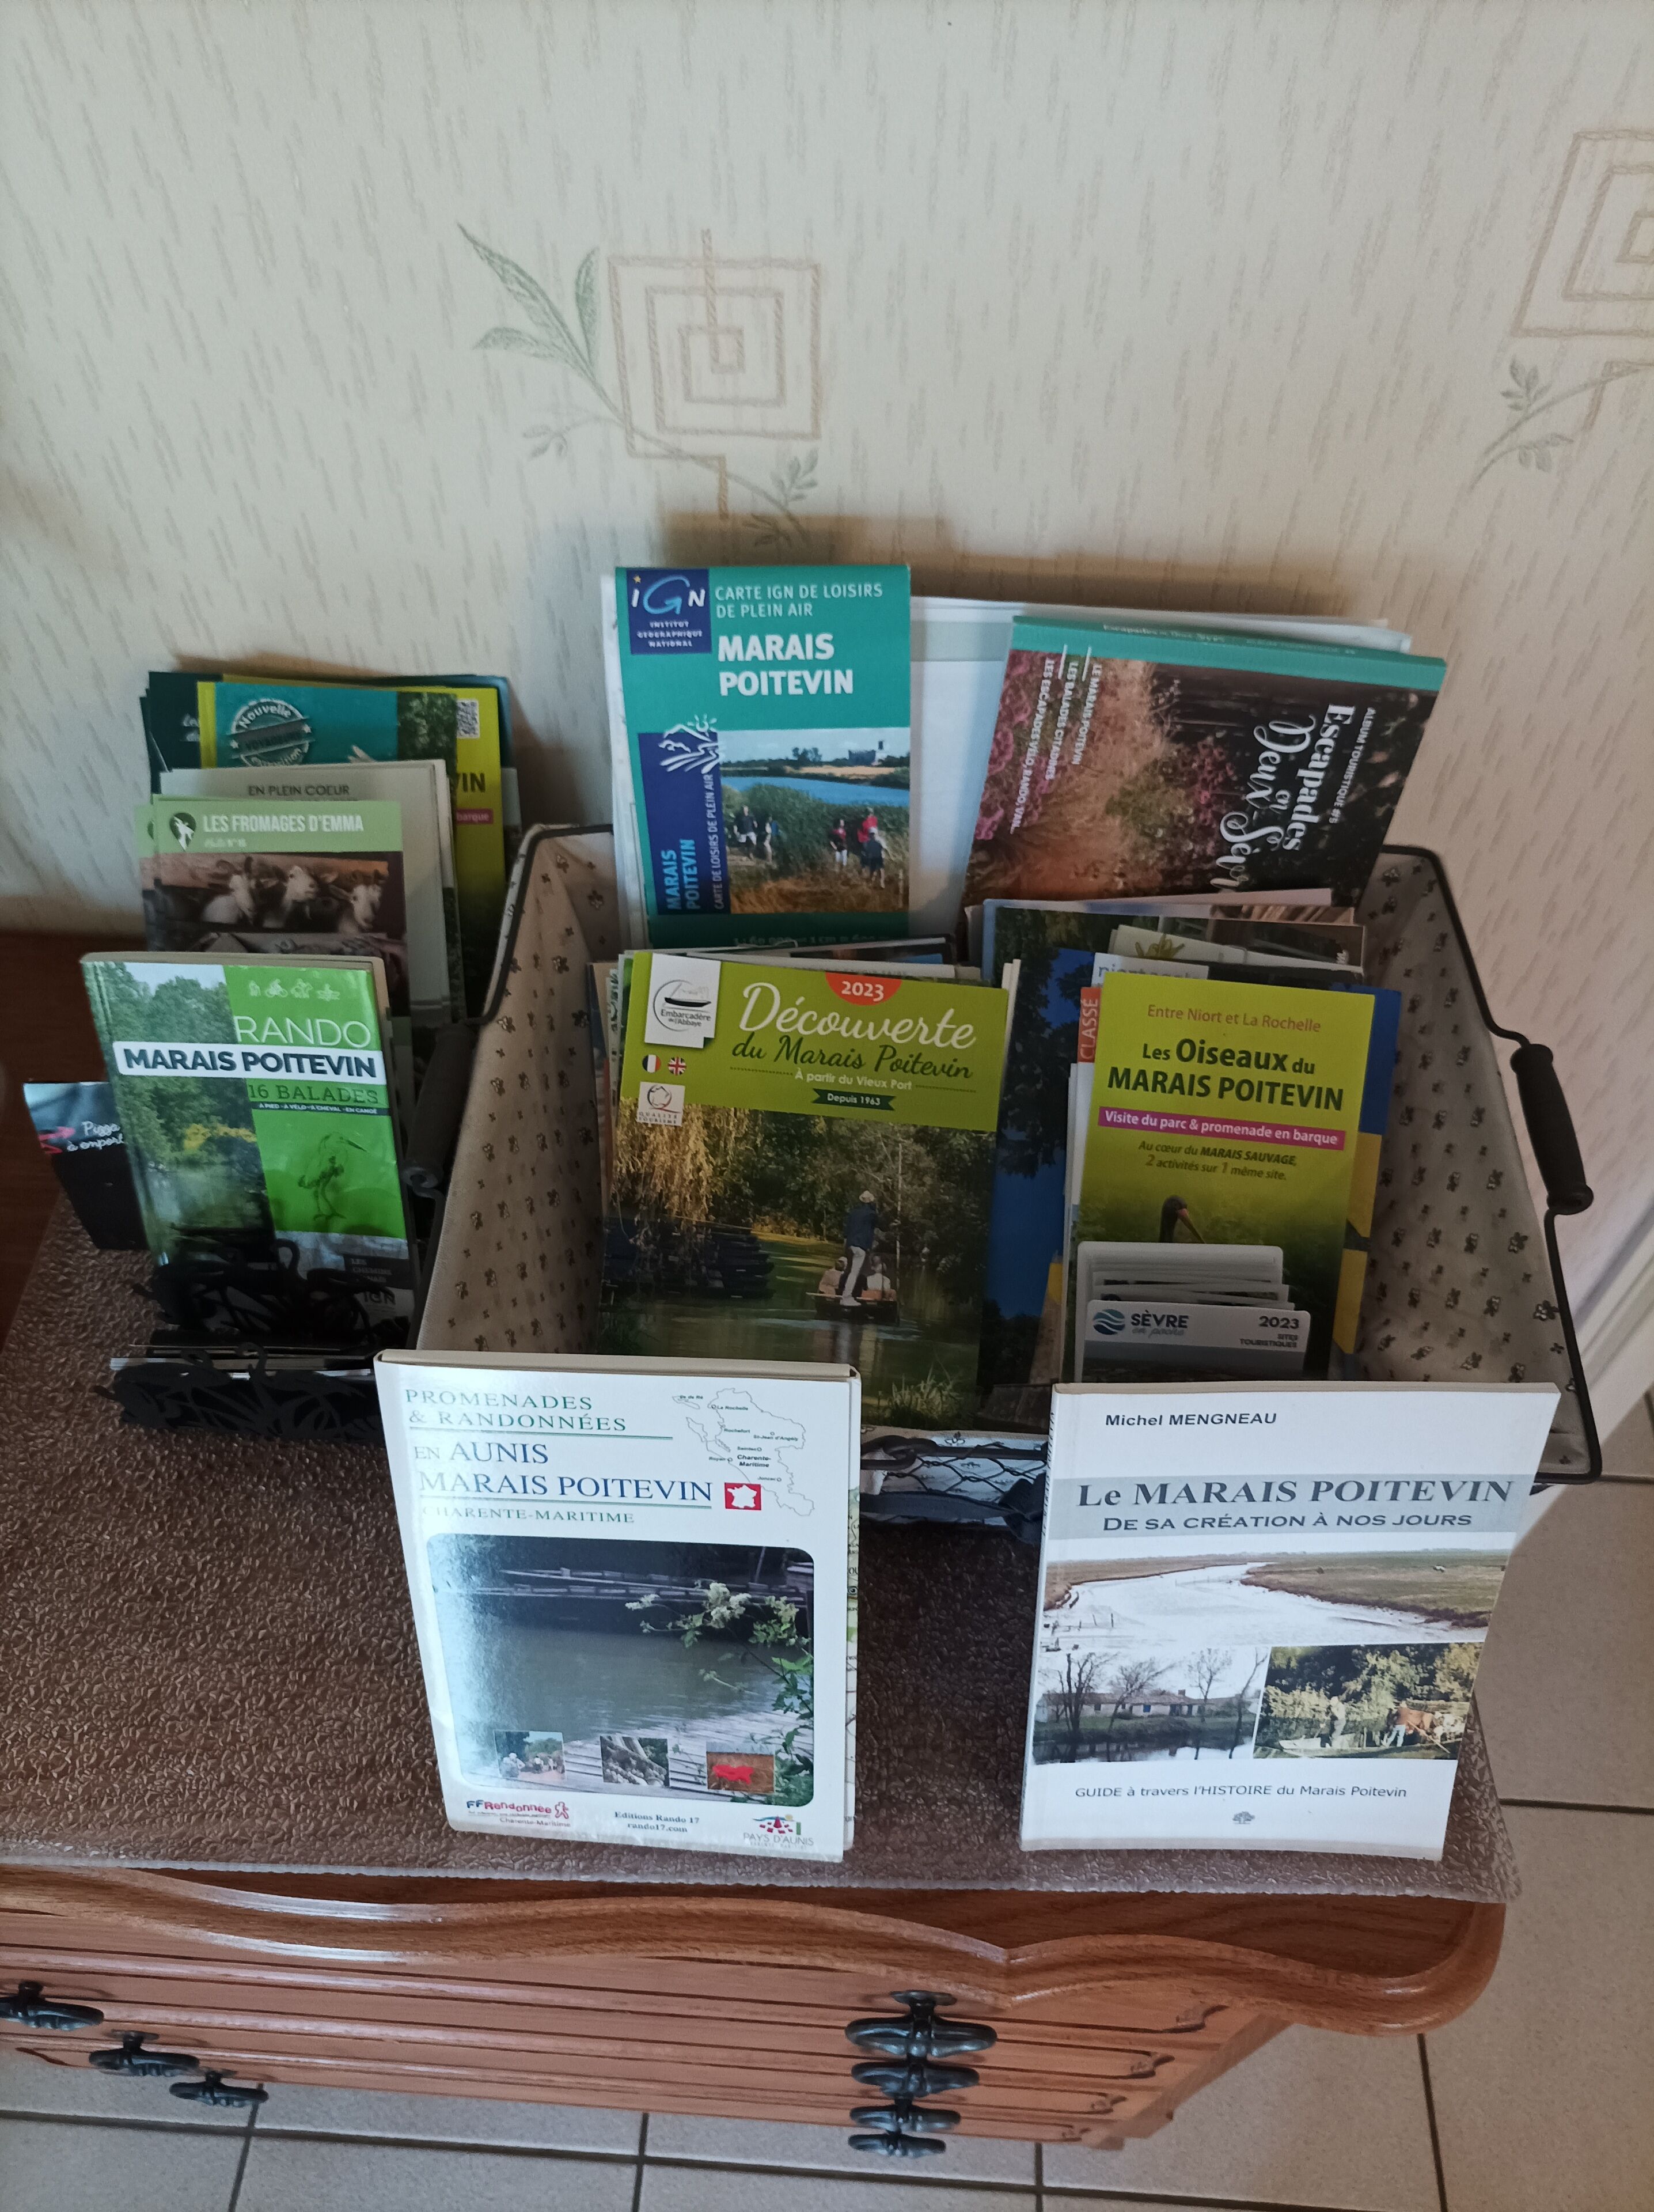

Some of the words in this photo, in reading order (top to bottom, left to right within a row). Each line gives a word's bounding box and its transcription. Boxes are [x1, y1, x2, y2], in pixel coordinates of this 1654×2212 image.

[631, 575, 705, 614] IGN
[715, 586, 761, 602] CARTE
[767, 585, 794, 600] IGN
[799, 585, 818, 599] DE
[823, 583, 883, 598] LOISIRS
[716, 605, 735, 619] DE
[741, 604, 782, 618] PLEIN
[787, 603, 813, 616] AIR
[648, 640, 692, 648] NATIONAL
[718, 633, 834, 662] MARAIS
[1043, 658, 1054, 677] LES
[1067, 662, 1078, 680] LES
[1092, 663, 1102, 677] LE
[720, 669, 853, 696] POITEVIN
[1031, 679, 1051, 740] ESCAPADES
[1057, 681, 1075, 729] BALADES
[1083, 678, 1099, 719] MARAIS
[238, 704, 293, 728] Nouvelle
[1356, 707, 1376, 744] ALBUM
[1072, 720, 1090, 765] POITEVIN
[1045, 729, 1064, 780] CITADINES
[703, 774, 714, 790] AIR
[1015, 768, 1033, 806] RANDO,
[1283, 704, 1356, 851] Escapades
[1334, 744, 1364, 808] TOURISTIQUE
[249, 785, 264, 796] EN
[268, 785, 301, 796] PLEIN
[305, 784, 350, 796] COEUR
[1210, 715, 1317, 888] Deux-Sèvr
[705, 791, 716, 819] PLEIN
[1269, 789, 1291, 815] en
[203, 815, 229, 832] LES
[233, 815, 305, 832] FROMAGES
[309, 813, 364, 832] D'EMMA
[707, 821, 717, 833] DE
[708, 834, 720, 868] LOISIRS
[661, 849, 682, 910] MARAIS
[680, 839, 700, 910] POITEVIN
[712, 870, 722, 881] DE
[714, 882, 724, 910] CARTE
[841, 980, 884, 1002] 2023
[661, 1009, 711, 1022] Embarcadère
[739, 982, 976, 1049] Découverte
[1148, 1004, 1183, 1020] Entre
[1187, 1007, 1221, 1023] Niort
[1226, 1012, 1239, 1024] et
[1243, 1012, 1257, 1026] La
[1262, 1014, 1321, 1033] Rochelle
[233, 1015, 371, 1048] RANDO
[1080, 998, 1098, 1059] CLASSÉ
[123, 1048, 237, 1072] MARAIS
[242, 1052, 377, 1077] POITEVIN
[732, 1031, 767, 1059] du
[773, 1035, 866, 1069] Marais
[874, 1044, 973, 1079] Poitevin
[1143, 1043, 1170, 1060] Les
[1175, 1038, 1288, 1073] Oiseaux
[1292, 1058, 1315, 1074] du
[795, 1067, 803, 1080] À
[806, 1072, 835, 1084] partir
[839, 1074, 853, 1085] du
[856, 1075, 887, 1088] Vieux
[890, 1079, 913, 1090] Port
[1108, 1066, 1211, 1099] MARAIS
[1217, 1077, 1343, 1111] POITEVIN
[248, 1084, 269, 1099] 16
[275, 1085, 379, 1104] BALADES
[827, 1093, 857, 1105] Depuis
[860, 1096, 881, 1106] 1963
[81, 1120, 121, 1137] Pizza
[1105, 1109, 1139, 1125] Visite
[1141, 1113, 1156, 1126] du
[1160, 1116, 1187, 1131] parc
[1189, 1119, 1198, 1130] &
[1201, 1120, 1272, 1138] promenade
[1274, 1129, 1289, 1139] en
[1293, 1129, 1337, 1146] barque
[79, 1133, 125, 1150] emport
[1138, 1141, 1154, 1151] Au
[1184, 1143, 1198, 1155] du
[1200, 1146, 1242, 1160] MARAIS
[1145, 1154, 1155, 1166] 2
[1156, 1157, 1198, 1171] activités
[1201, 1163, 1217, 1173] sur
[1221, 1162, 1227, 1173] 1
[1230, 1164, 1264, 1177] même
[1131, 1309, 1189, 1329] SÈVRE
[1259, 1315, 1300, 1330] 2023
[405, 1389, 592, 1411] PROMENADES
[409, 1409, 426, 1423] &
[439, 1411, 627, 1432] RANDONNÉES
[1105, 1413, 1164, 1427] Michel
[1169, 1412, 1277, 1426] MENGNEAU
[415, 1446, 440, 1461] EN
[450, 1442, 549, 1465] AUNIS
[419, 1471, 548, 1495] MARAIS
[559, 1476, 711, 1501] POITEVIN
[1078, 1484, 1121, 1507] Le
[1132, 1480, 1297, 1505] MARAIS
[1309, 1479, 1516, 1503] POITEVIN
[1103, 1517, 1139, 1531] DE
[1145, 1517, 1177, 1530] SA
[1183, 1512, 1306, 1529] CRÉATION
[1312, 1512, 1330, 1527] À
[1337, 1514, 1387, 1527] NOS
[1392, 1514, 1473, 1527] JOURS
[1075, 1787, 1122, 1798] GUIDE
[1127, 1786, 1135, 1797] à
[1140, 1786, 1189, 1797] travers
[1194, 1785, 1272, 1797] l'HISTOIRE
[1277, 1785, 1295, 1796] du
[1300, 1785, 1345, 1796] Marais
[1350, 1785, 1407, 1797] Poitevin
[614, 1811, 654, 1822] Editions
[656, 1813, 686, 1823] Rando
[689, 1816, 700, 1824] 17
[627, 1821, 688, 1833] rando17.com
[743, 1832, 770, 1842] PAYS
[773, 1835, 814, 1846] D'AUNIS
